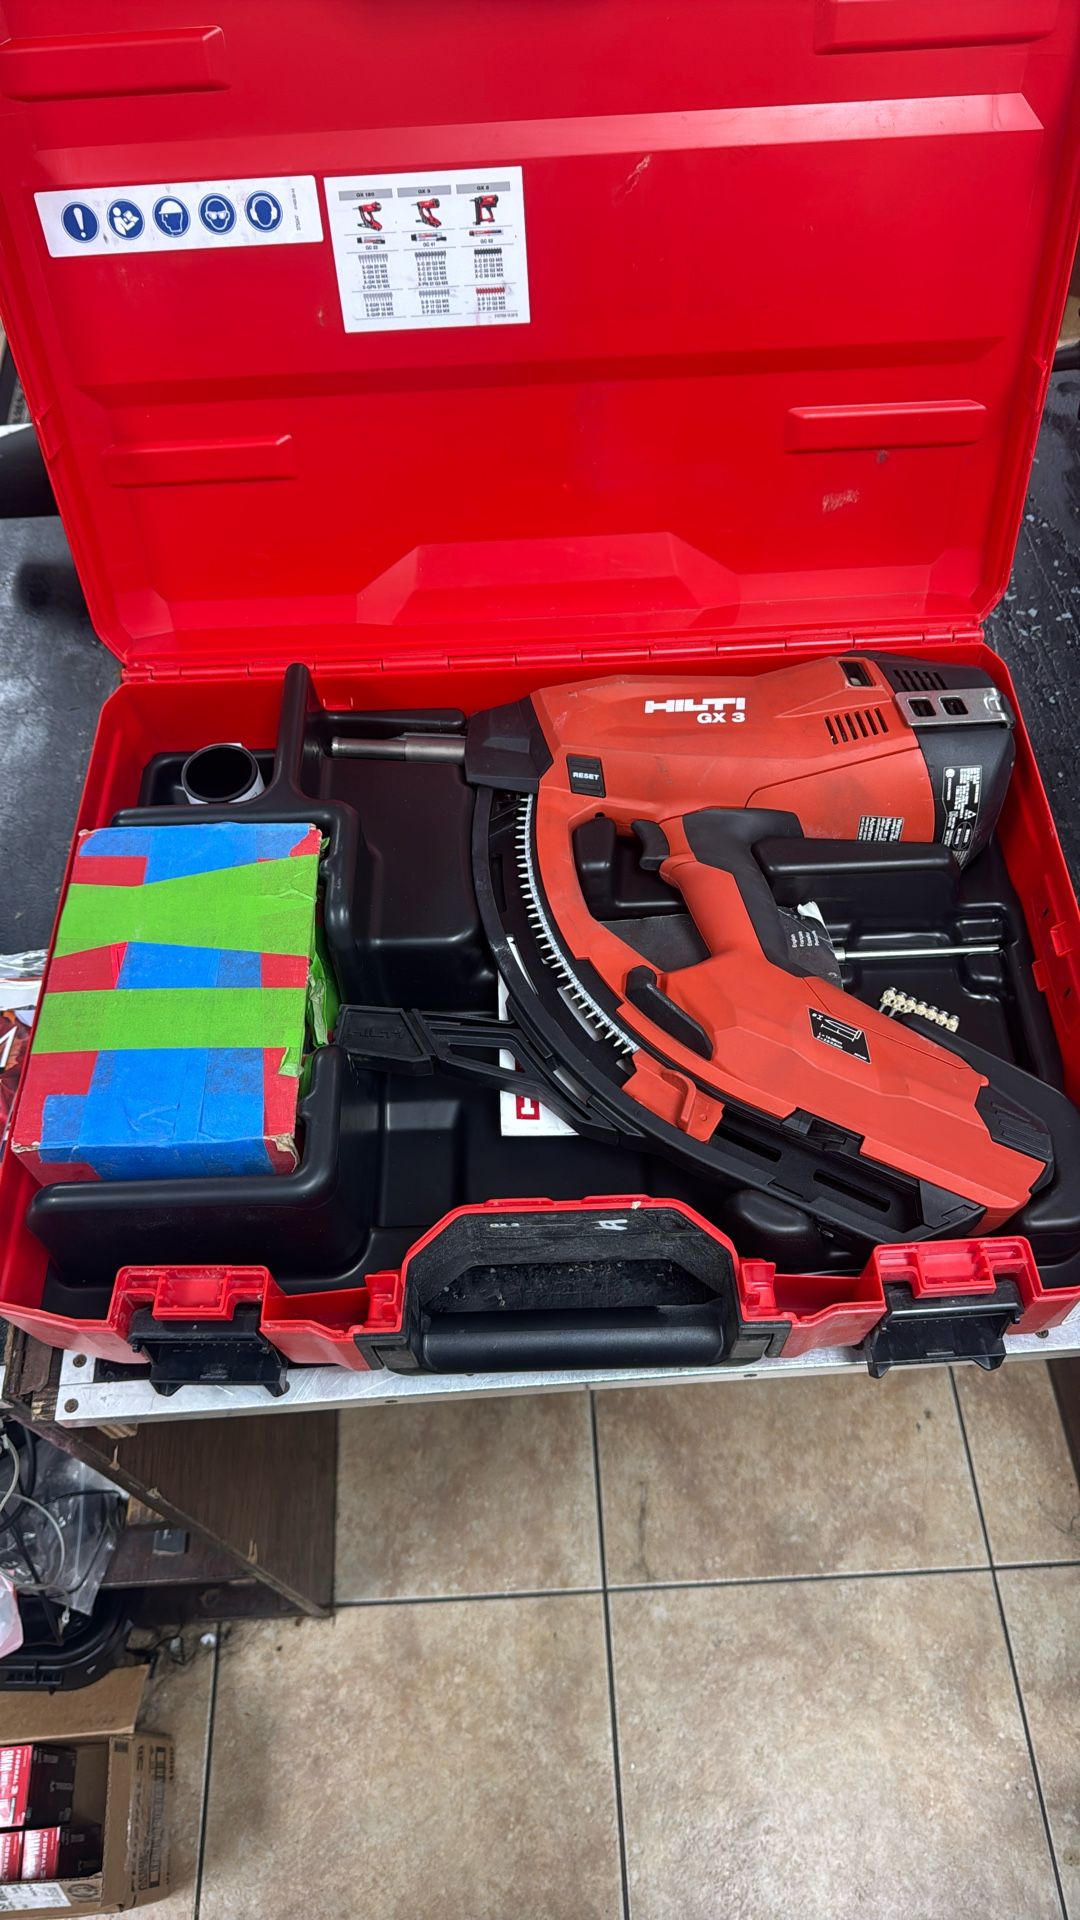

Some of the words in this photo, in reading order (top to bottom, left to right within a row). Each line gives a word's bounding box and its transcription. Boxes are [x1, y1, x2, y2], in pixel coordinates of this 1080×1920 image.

[644, 698, 746, 714] HILTI
[696, 712, 726, 724] GX
[732, 712, 746, 722] 3
[572, 772, 600, 780] RESET
[12, 1749, 22, 1785] FEDERAL
[2, 1836, 12, 1872] FEDERAL
[40, 1832, 48, 1868] FEDERAL
